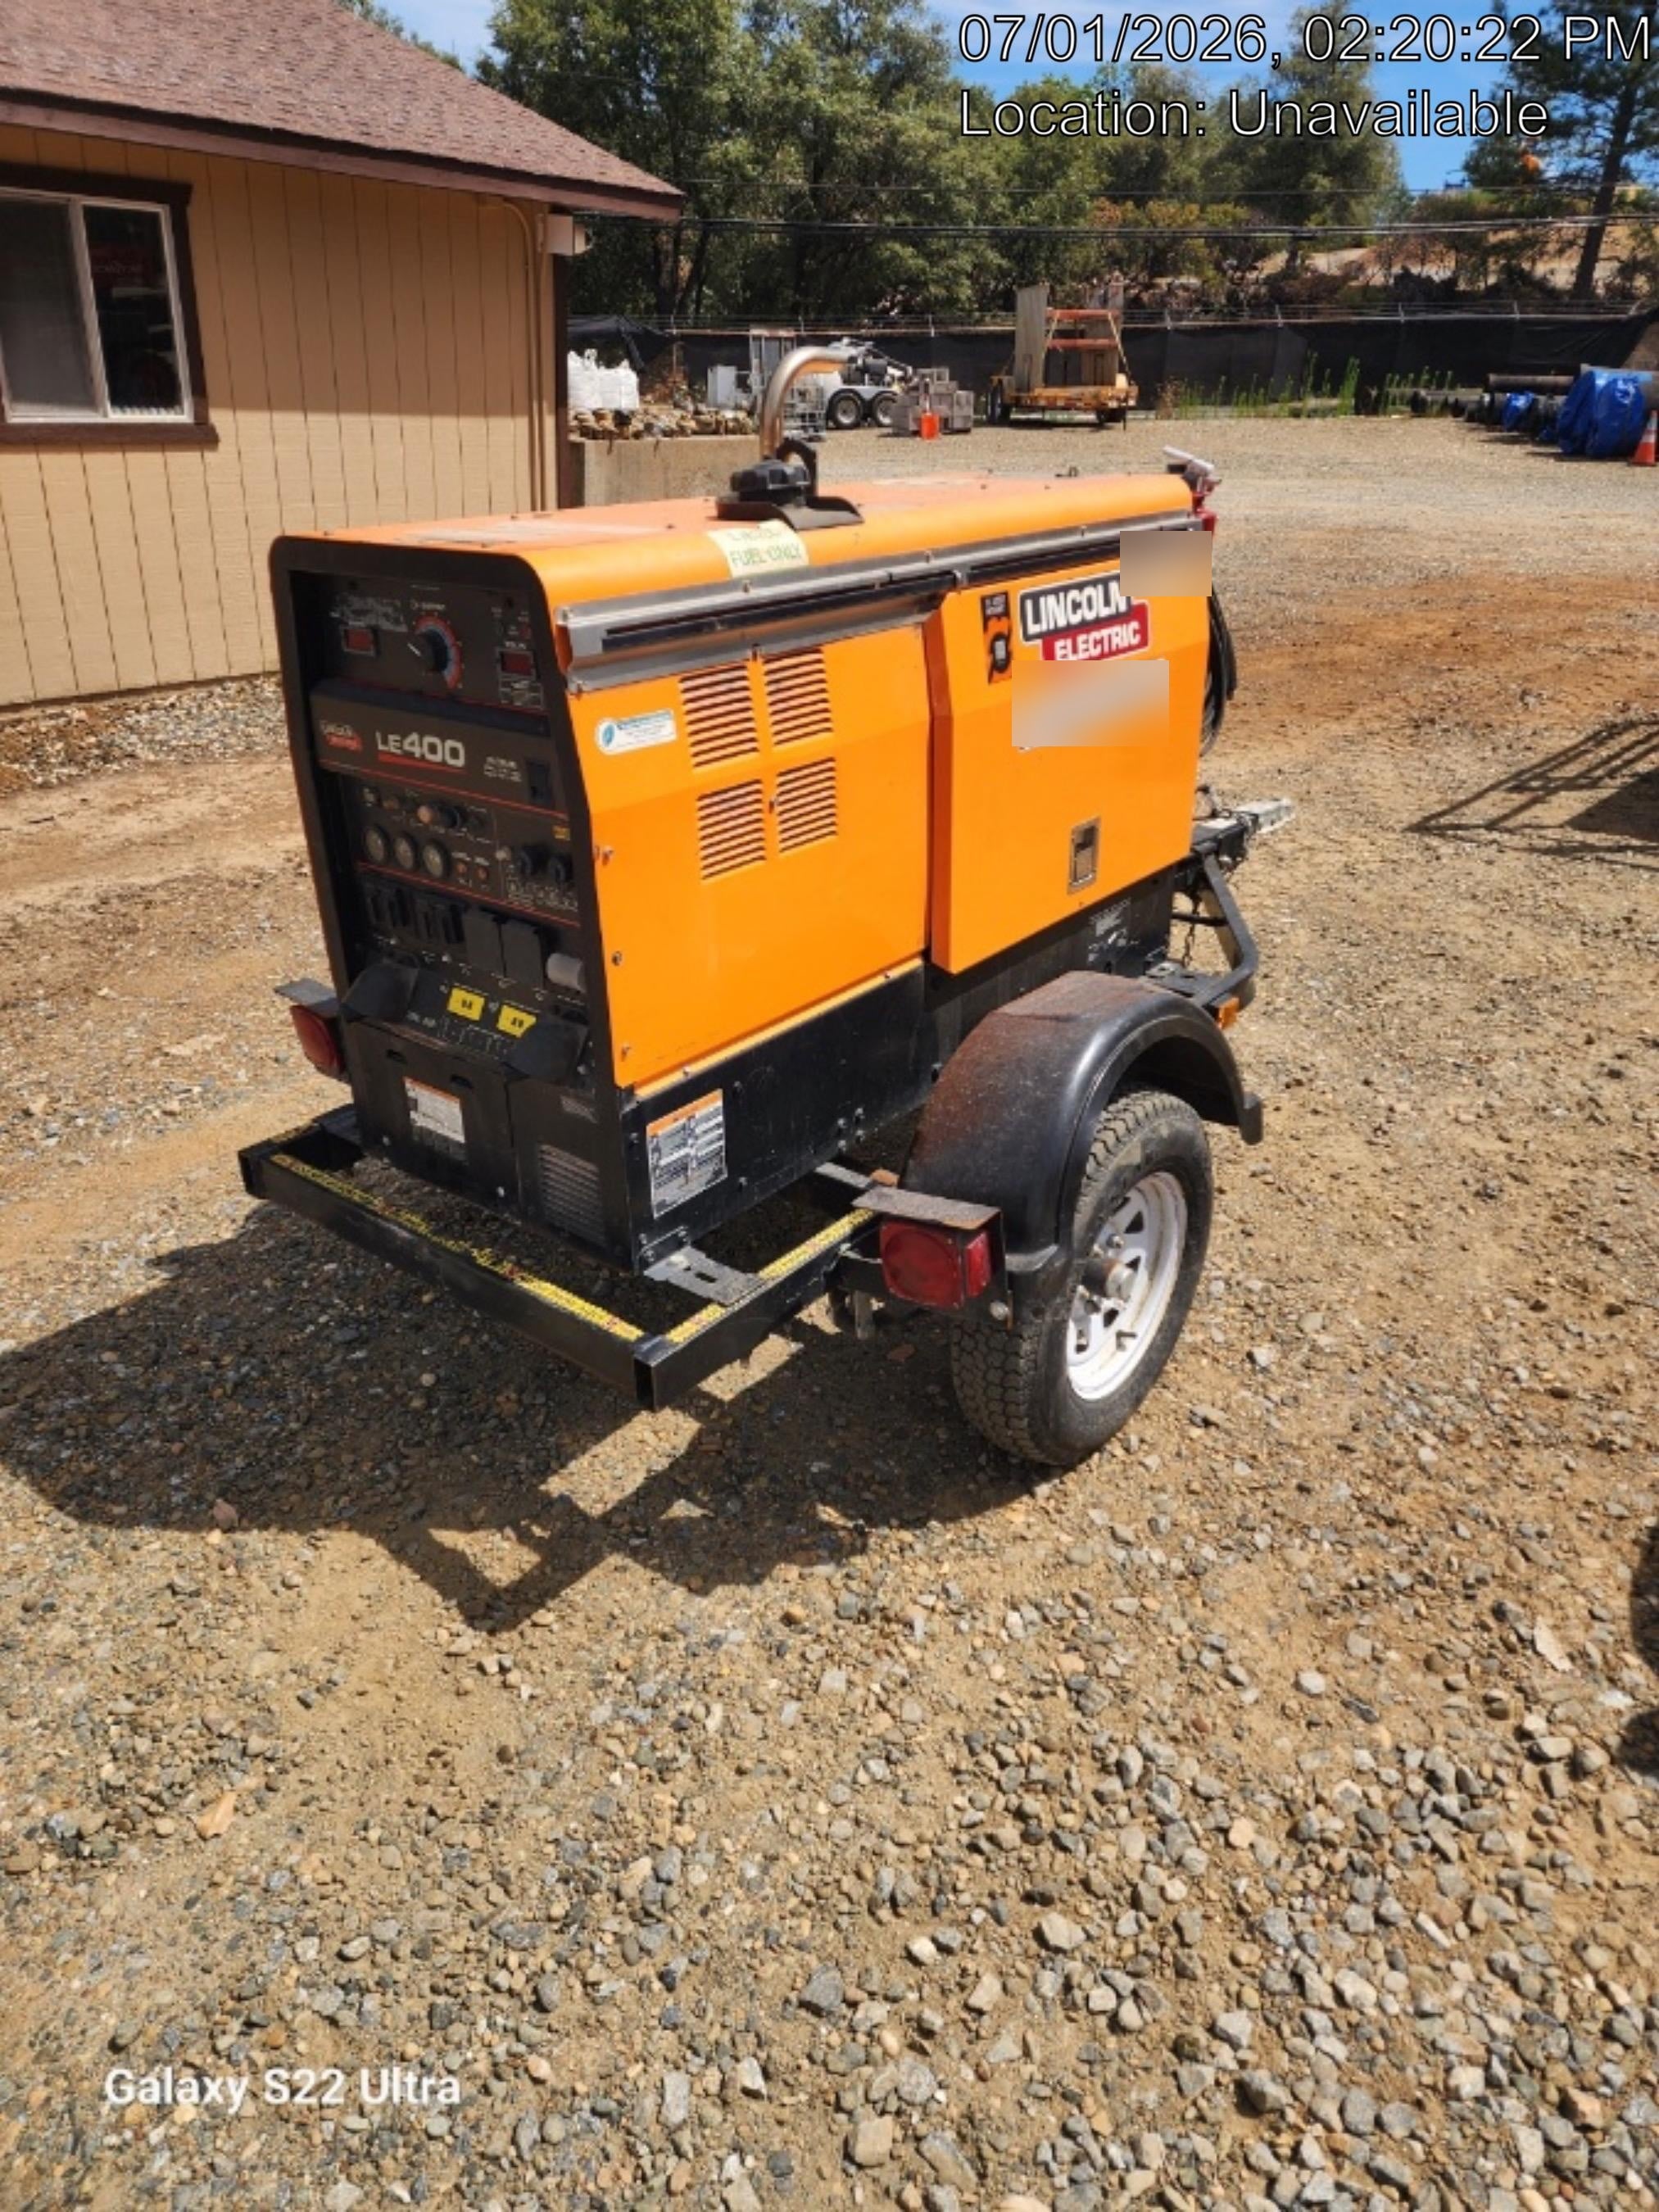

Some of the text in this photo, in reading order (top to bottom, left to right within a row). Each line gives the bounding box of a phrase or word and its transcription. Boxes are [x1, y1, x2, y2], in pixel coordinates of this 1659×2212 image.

[1025, 579, 1128, 636] LINCOLN
[1054, 619, 1142, 661] ELECTRIC
[375, 730, 465, 768] LE400
